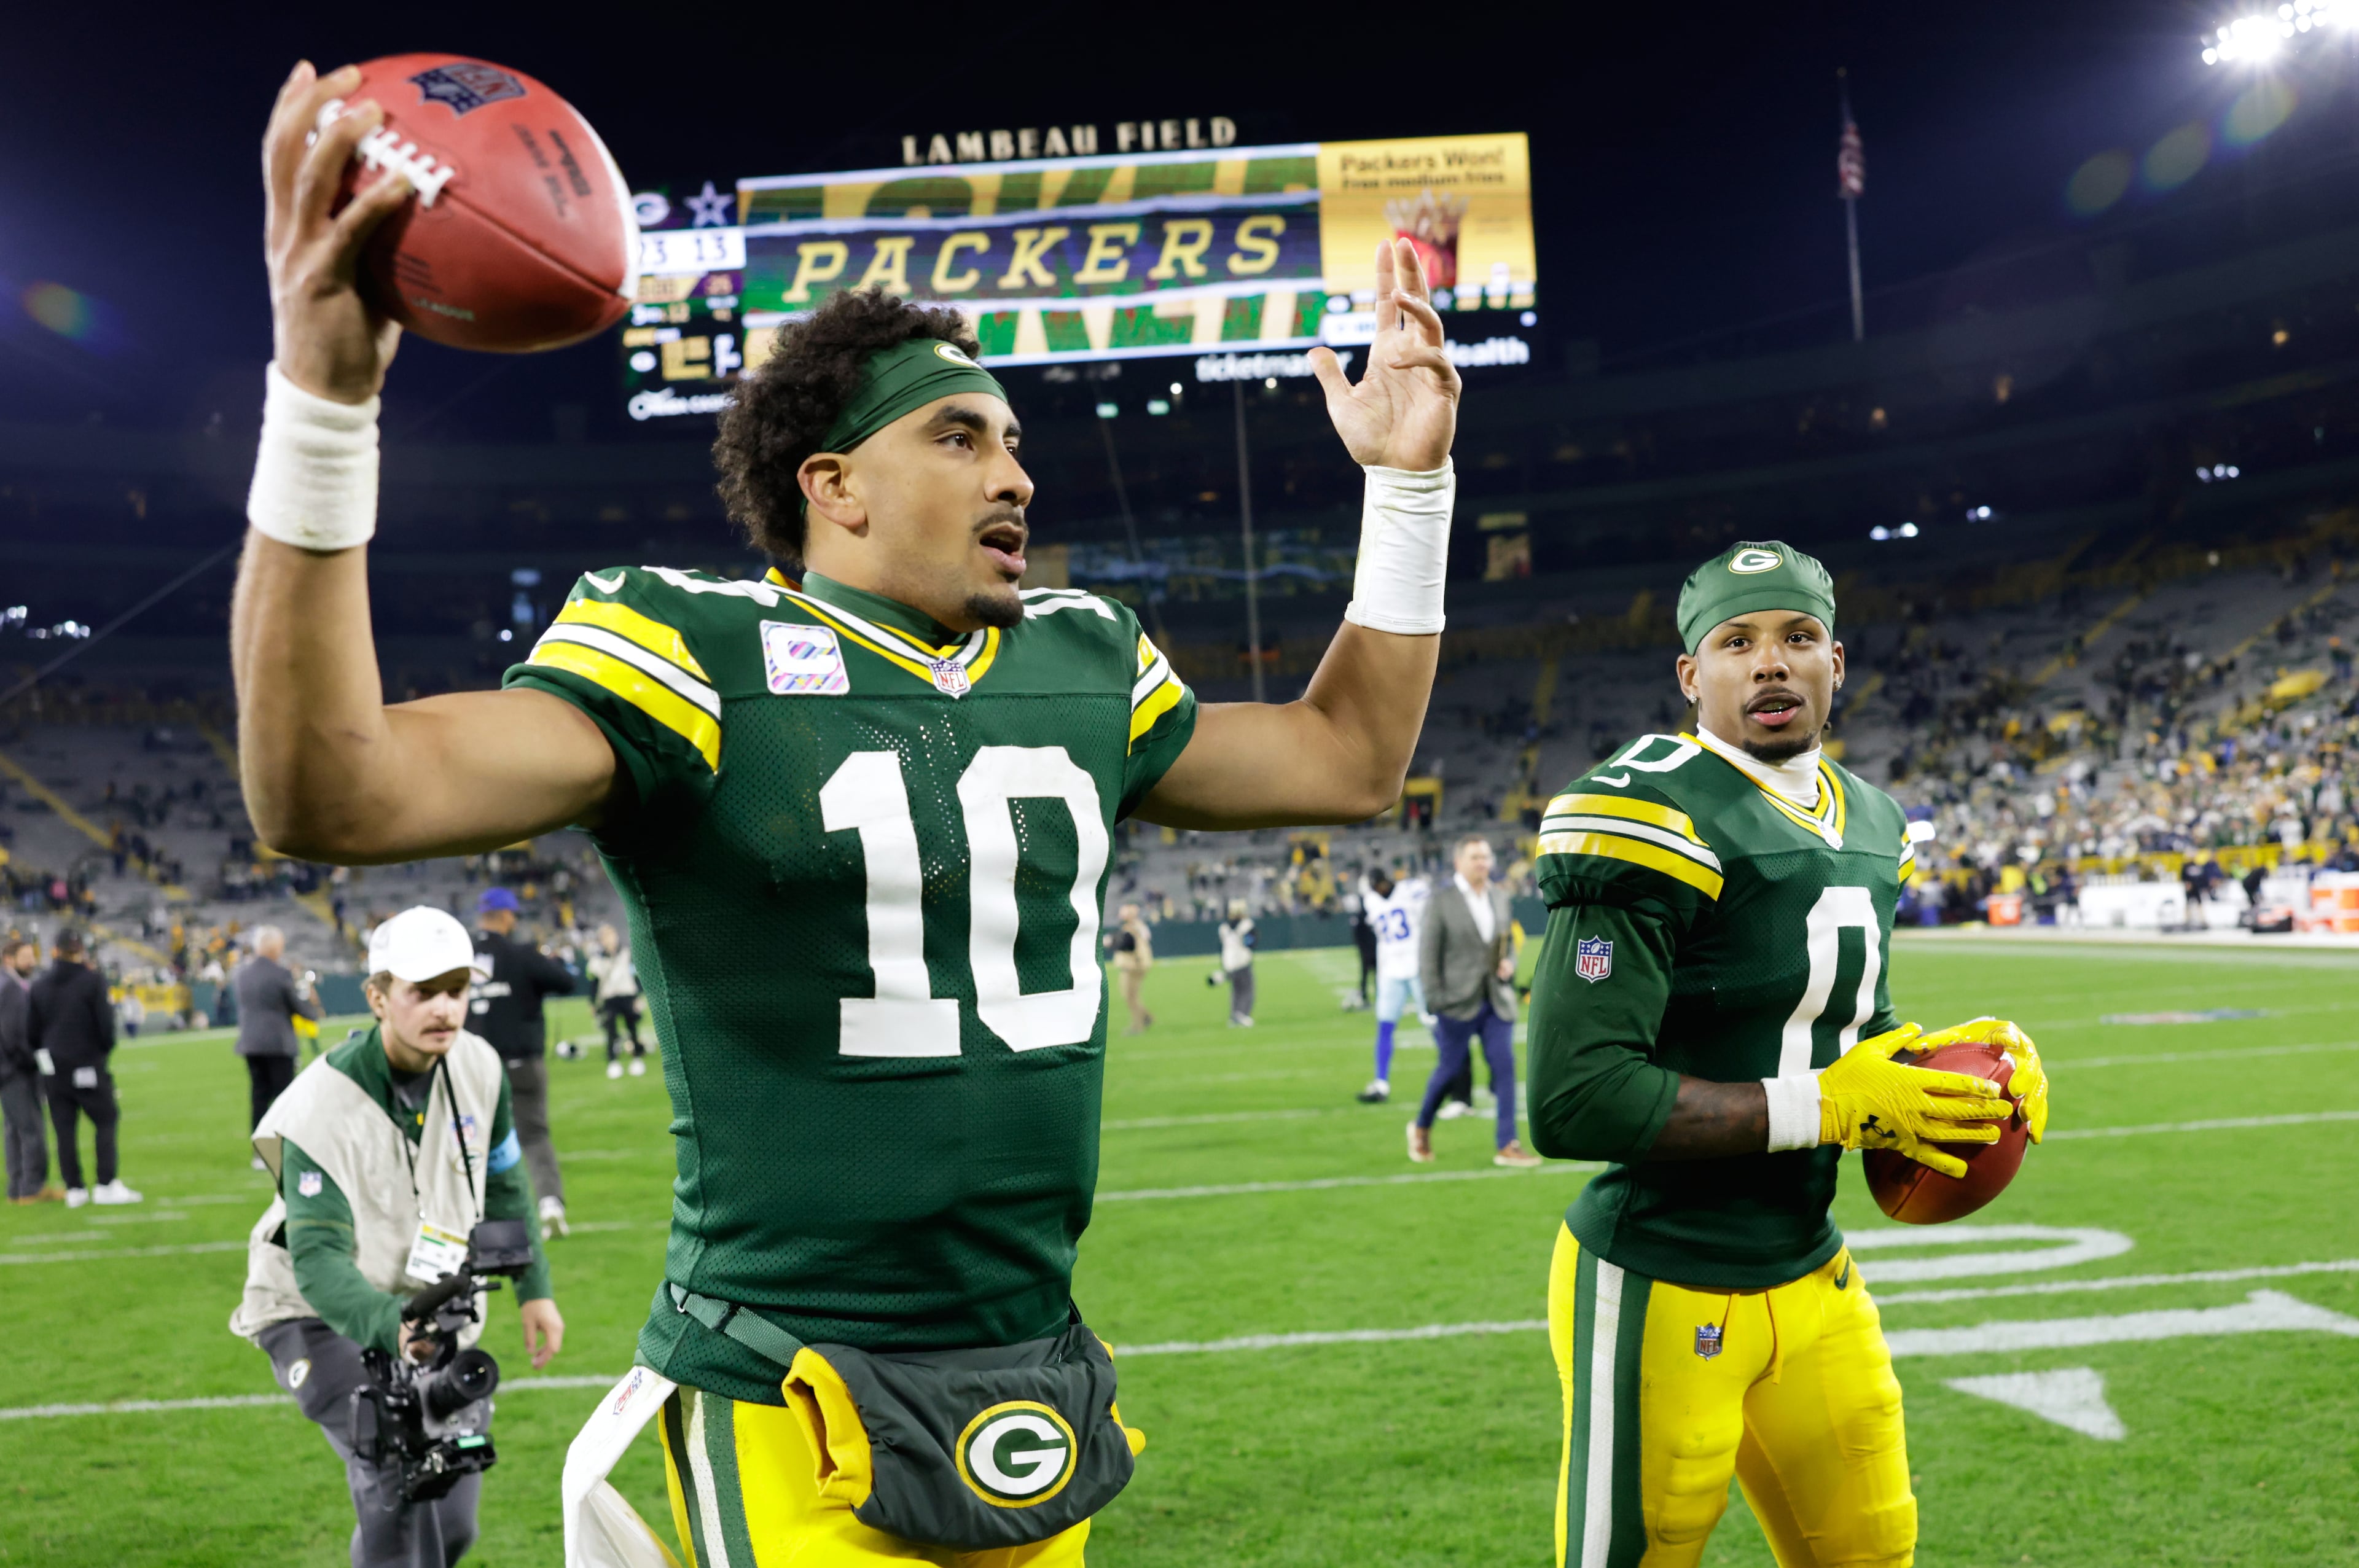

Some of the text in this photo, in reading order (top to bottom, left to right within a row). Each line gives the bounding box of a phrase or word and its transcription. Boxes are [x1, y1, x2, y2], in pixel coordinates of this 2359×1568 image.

[901, 116, 1237, 166] LAMBEAU FIELD
[1340, 150, 1436, 171] Packers
[781, 214, 1287, 303] PACKERS
[1195, 351, 1354, 383] ticketmasr
[1730, 549, 1780, 572] G
[767, 626, 839, 675] C
[939, 673, 964, 689] NFL
[818, 745, 1109, 1058] 10
[1580, 955, 1607, 977] NFL
[1777, 886, 1881, 1078] 0
[1700, 1340, 1719, 1354] NFL
[969, 1414, 1068, 1495] G
